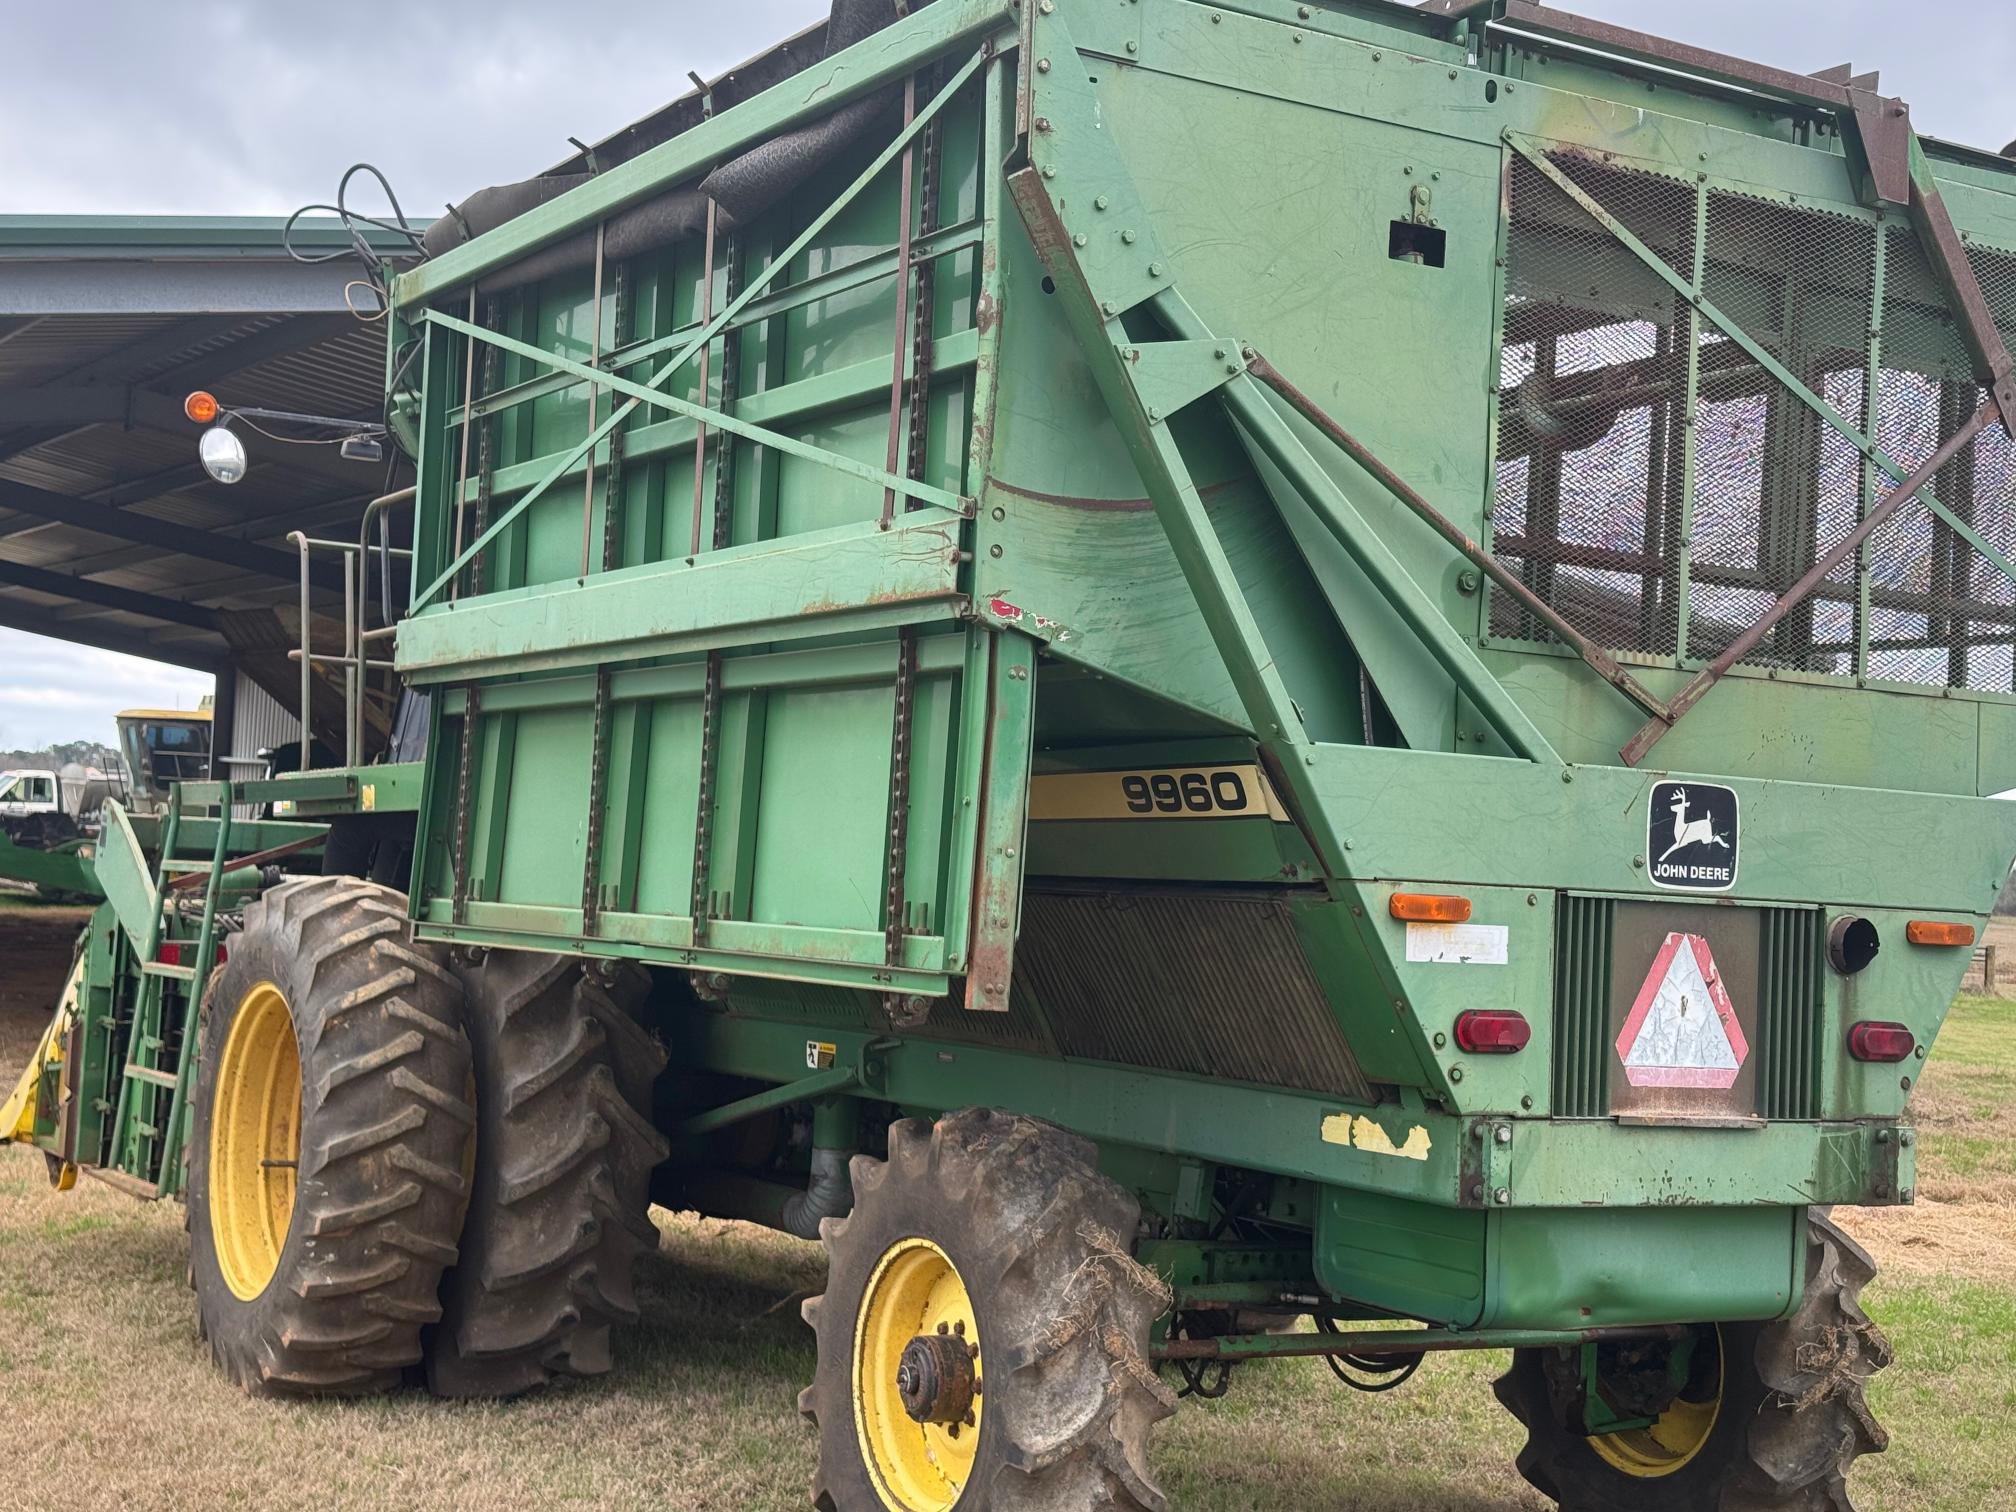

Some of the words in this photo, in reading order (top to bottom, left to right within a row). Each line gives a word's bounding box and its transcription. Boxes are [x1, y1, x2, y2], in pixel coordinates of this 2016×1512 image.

[1122, 772, 1247, 812] 9960
[1654, 864, 1687, 878] JOHN
[1690, 866, 1729, 880] DEERE
